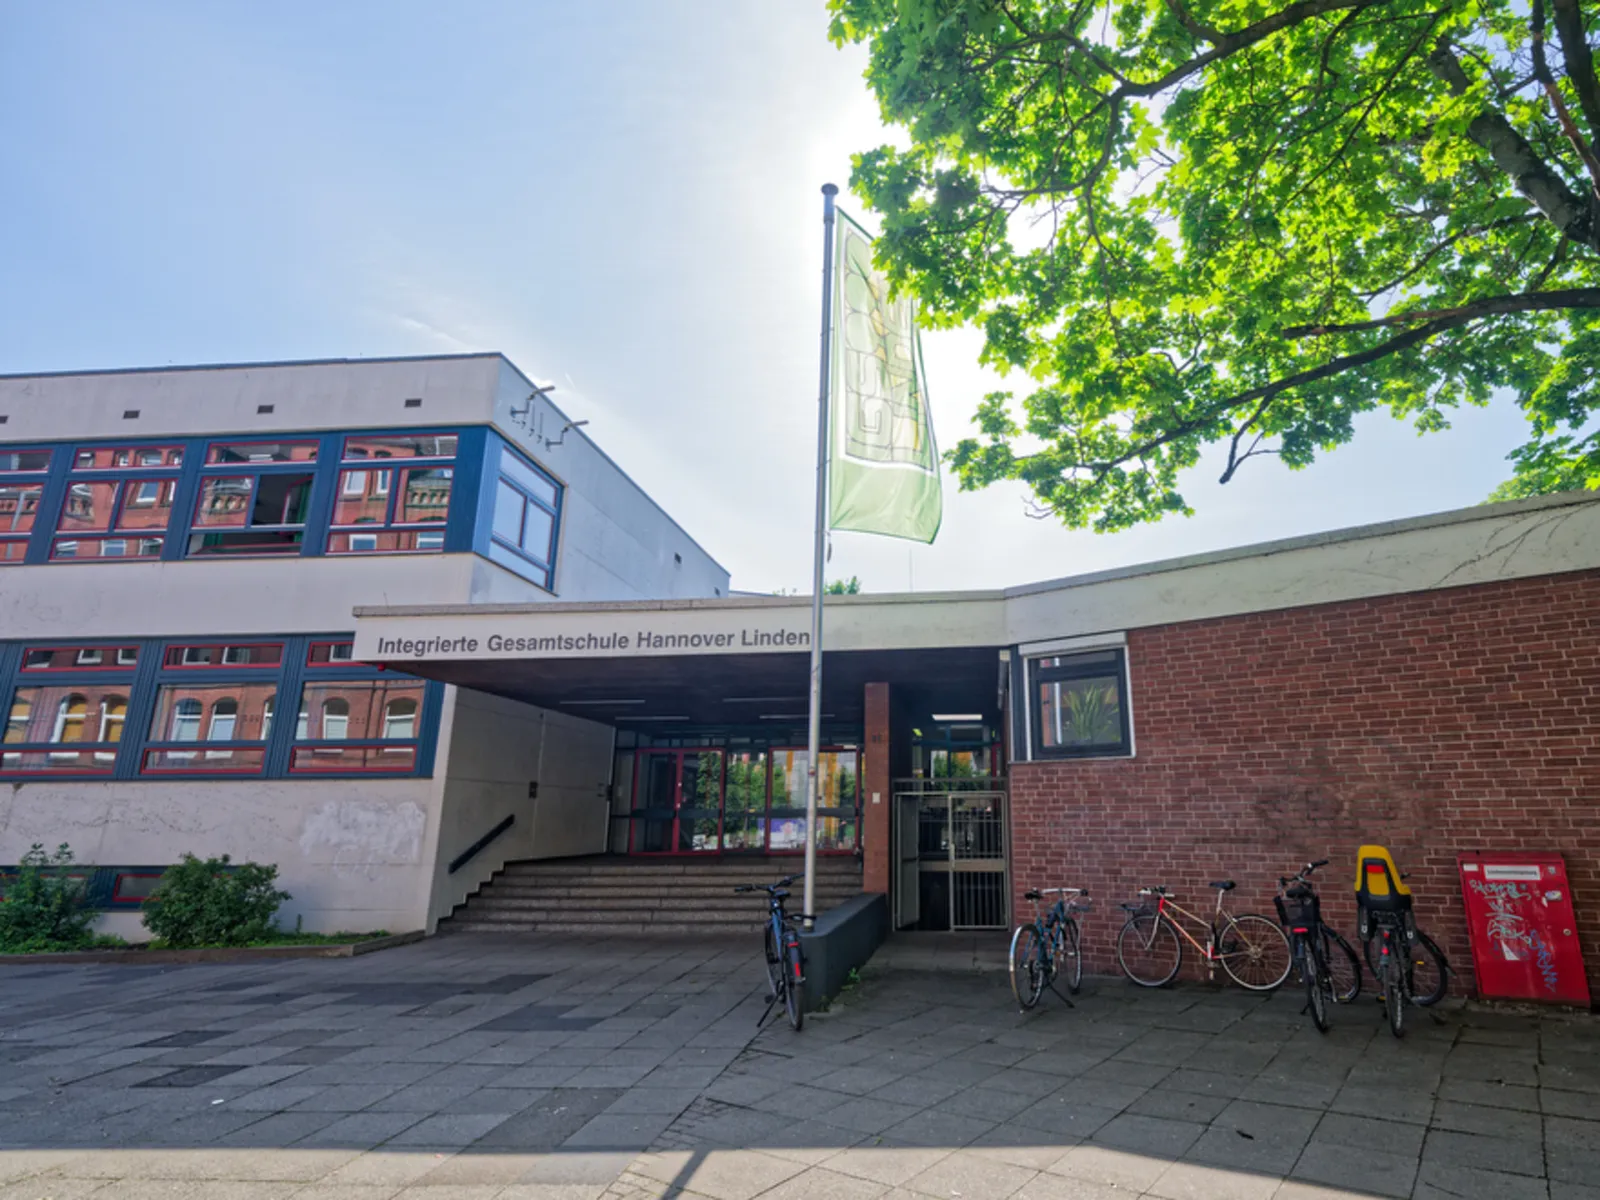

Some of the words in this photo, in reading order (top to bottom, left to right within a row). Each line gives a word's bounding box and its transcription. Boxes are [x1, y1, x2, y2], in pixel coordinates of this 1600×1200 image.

[377, 636, 478, 657] Integrierte
[487, 632, 630, 652] Gesamtschule
[637, 631, 735, 649] Hannover
[741, 628, 810, 646] Linden
